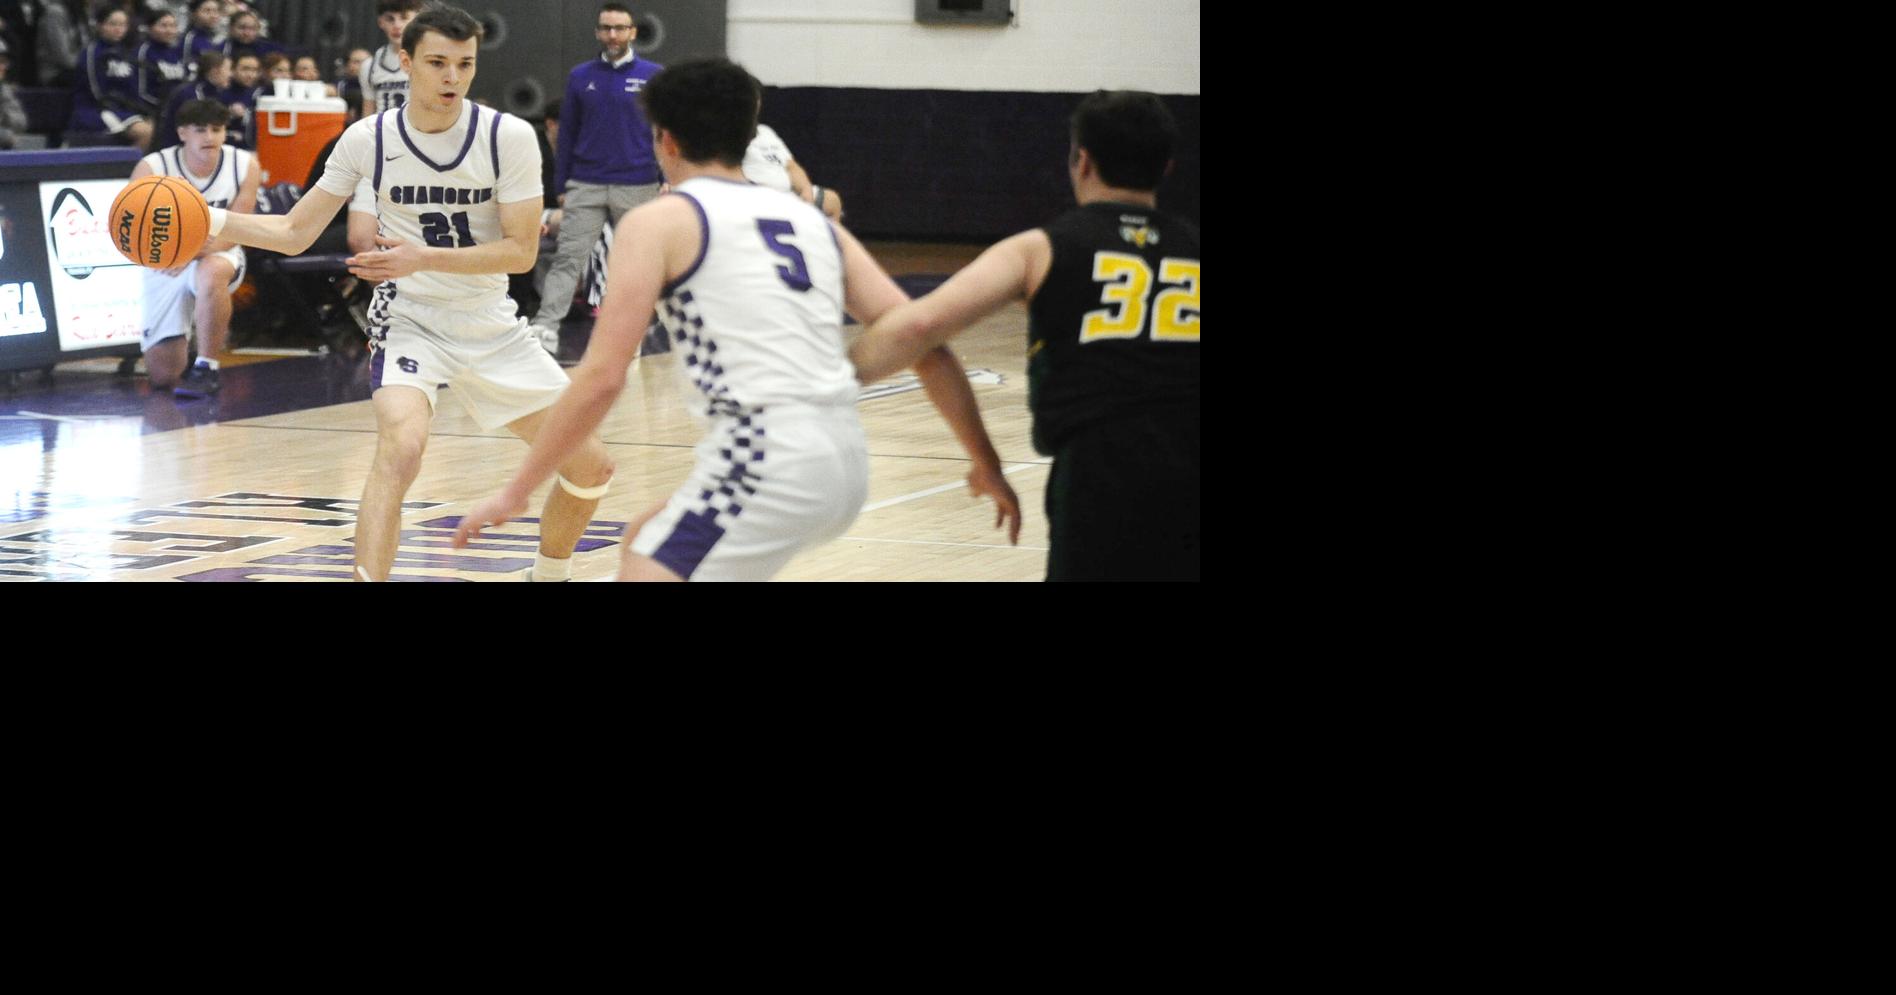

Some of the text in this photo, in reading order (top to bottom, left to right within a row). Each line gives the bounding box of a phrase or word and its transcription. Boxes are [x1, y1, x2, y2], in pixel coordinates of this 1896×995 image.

[149, 206, 171, 264] Wilson
[418, 211, 477, 248] 21
[755, 218, 813, 292] 5
[1079, 250, 1200, 344] 32
